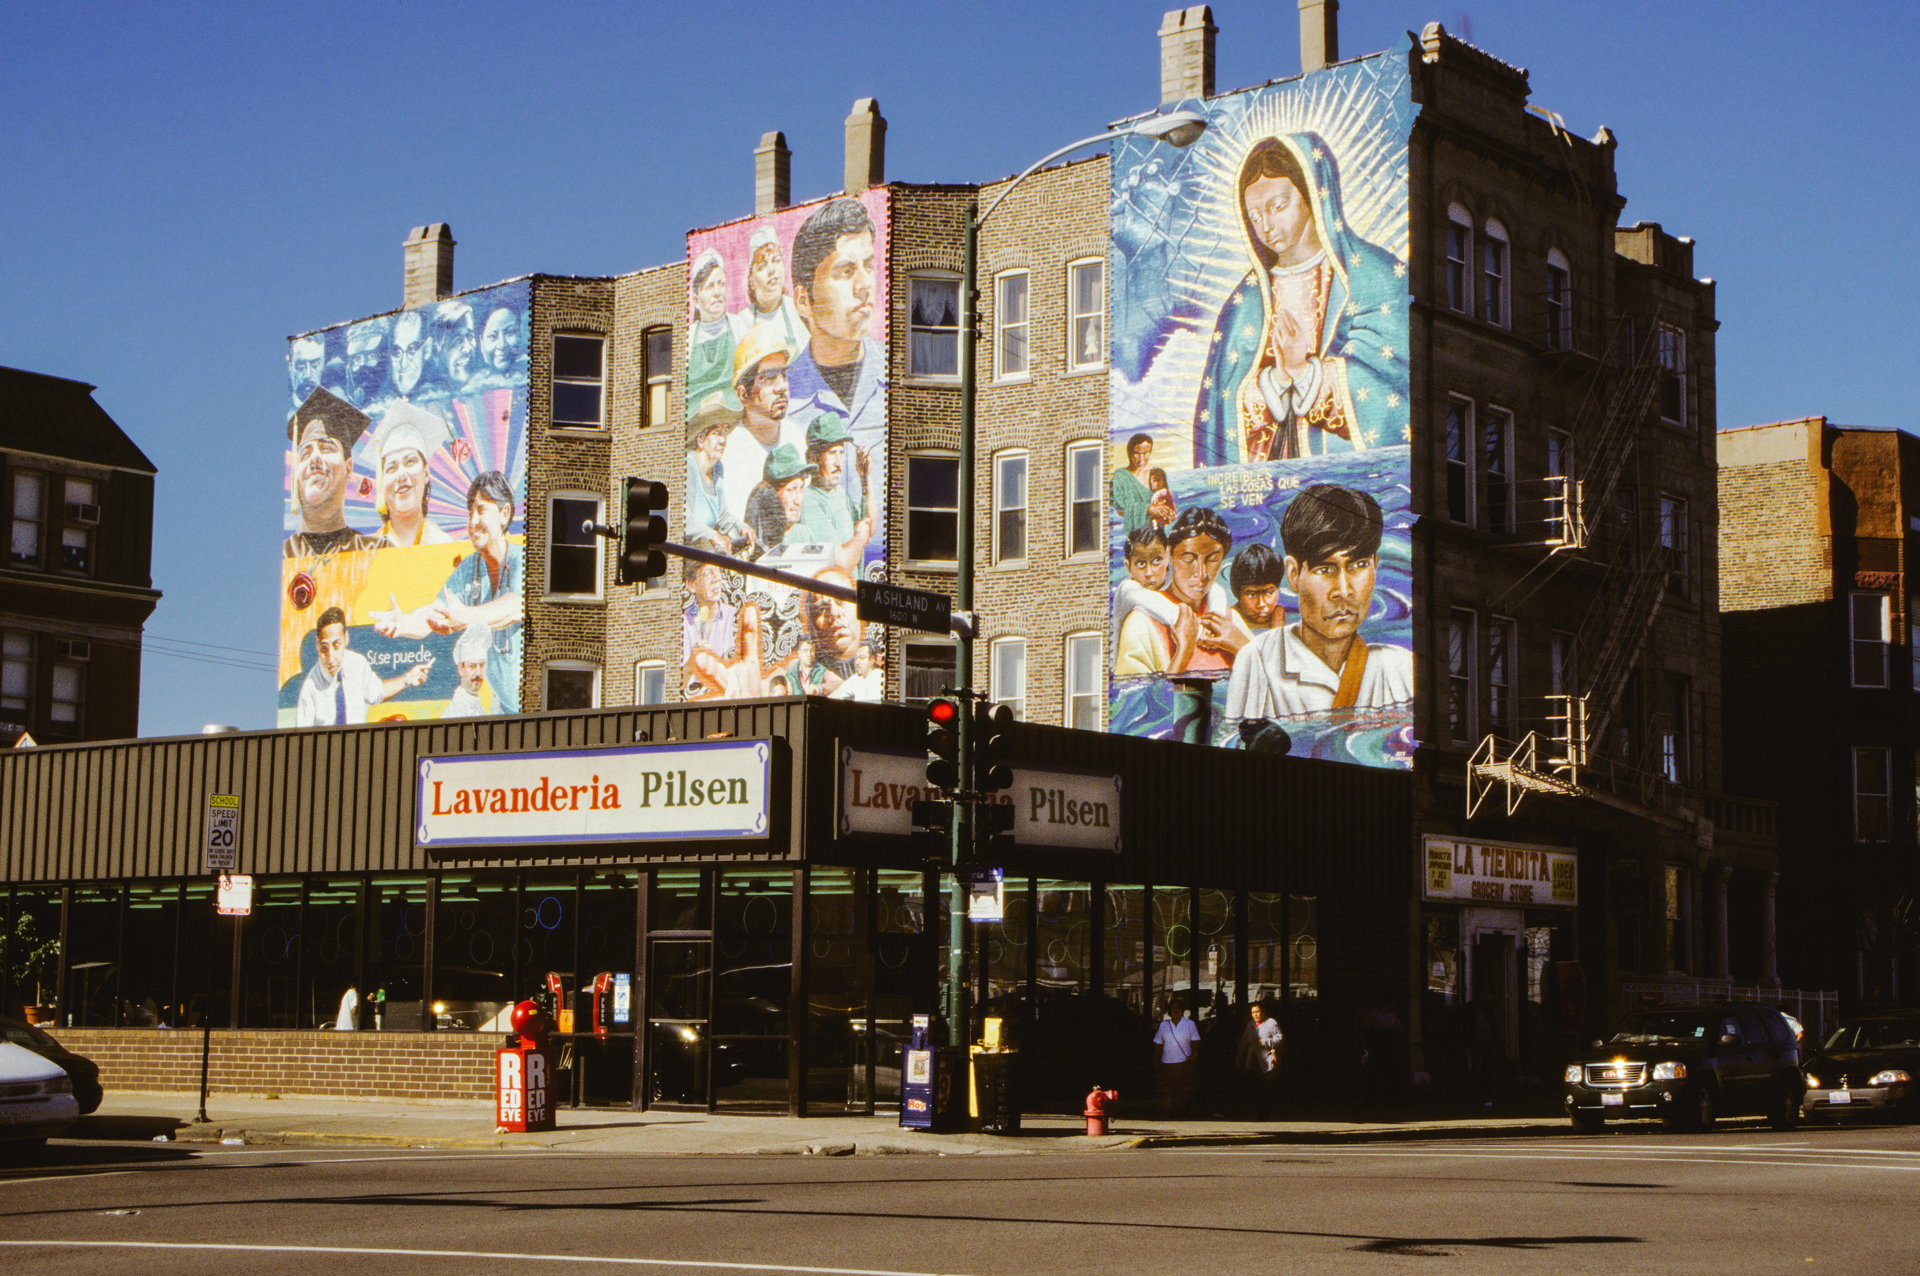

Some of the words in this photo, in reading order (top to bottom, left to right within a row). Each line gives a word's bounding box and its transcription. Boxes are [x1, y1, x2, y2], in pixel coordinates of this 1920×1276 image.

[1220, 482, 1239, 495] LAS
[1241, 480, 1274, 493] COSAS
[1278, 476, 1300, 489] QUE
[1221, 495, 1236, 509] SE
[1241, 493, 1263, 506] VEN
[861, 588, 866, 600] S
[874, 589, 928, 612] ASHLAND
[935, 602, 946, 613] AV
[890, 609, 908, 622] 1600
[912, 613, 919, 624] W
[378, 652, 391, 665] se
[393, 644, 432, 670] puede
[211, 796, 238, 806] SCHOOL
[432, 775, 622, 816] Lavanderia
[640, 770, 749, 808] Pilsen
[212, 809, 236, 819] SPEED
[1029, 786, 1110, 828] Pilsen
[213, 819, 232, 828] LIMIT
[211, 829, 234, 847] 20
[1453, 844, 1474, 876] LA
[1480, 847, 1550, 882] TIENDITA
[1553, 862, 1574, 879] VIDEO
[1471, 880, 1504, 900] GROCERY
[1509, 884, 1534, 902] STORE
[500, 1052, 521, 1089] R
[527, 1053, 546, 1089] R
[501, 1089, 521, 1109] ED
[527, 1089, 545, 1109] ED
[501, 1109, 521, 1122] EYE
[527, 1108, 546, 1122] EYE
